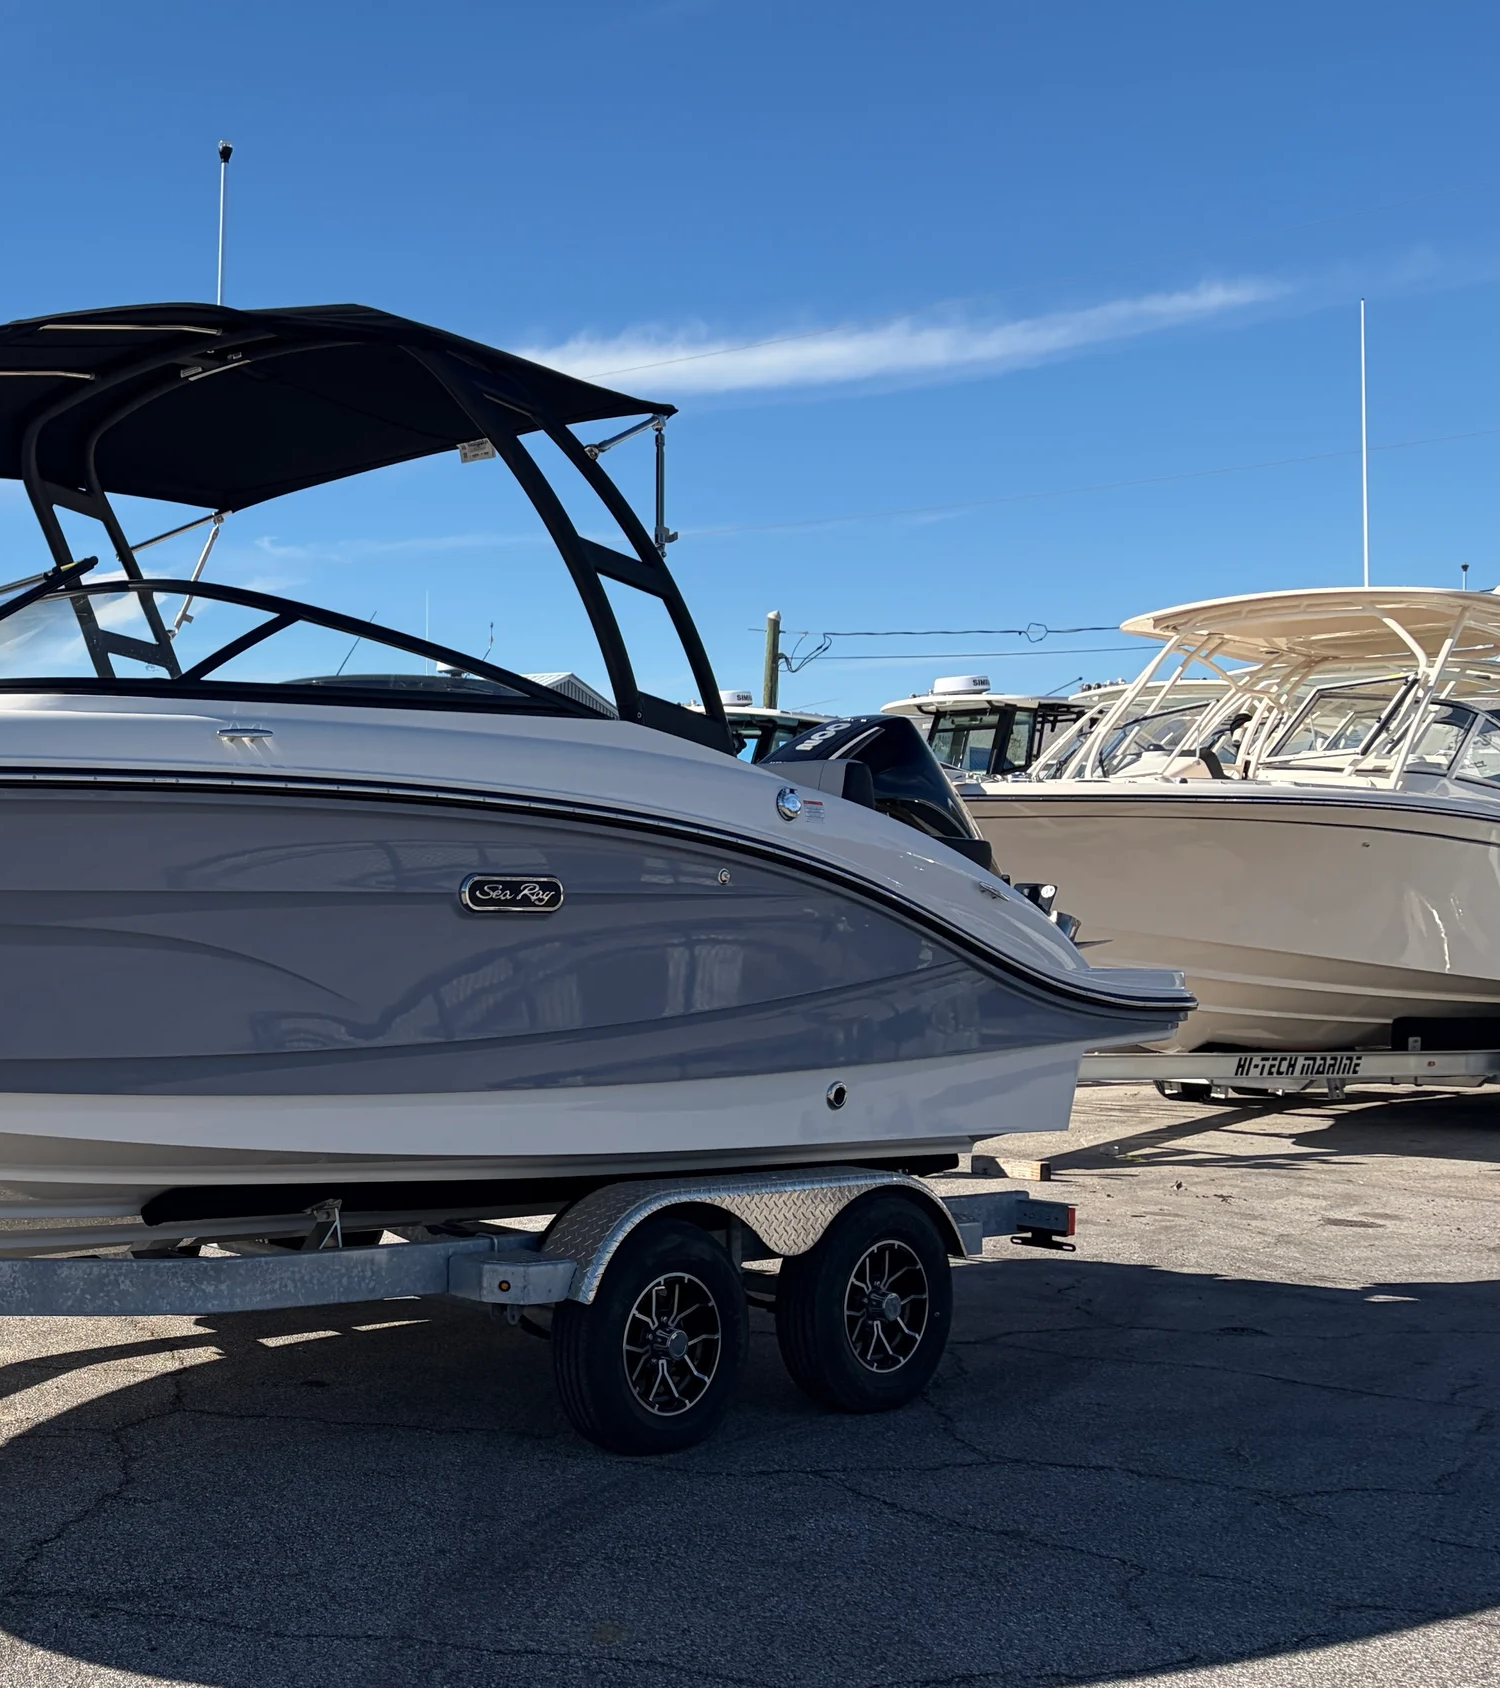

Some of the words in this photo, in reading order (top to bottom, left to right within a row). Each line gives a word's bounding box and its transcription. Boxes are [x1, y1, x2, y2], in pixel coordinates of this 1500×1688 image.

[476, 884, 514, 900] Sea
[516, 883, 555, 906] Ray
[1234, 1056, 1298, 1077] HI-TECH
[1300, 1055, 1363, 1076] MARINE
